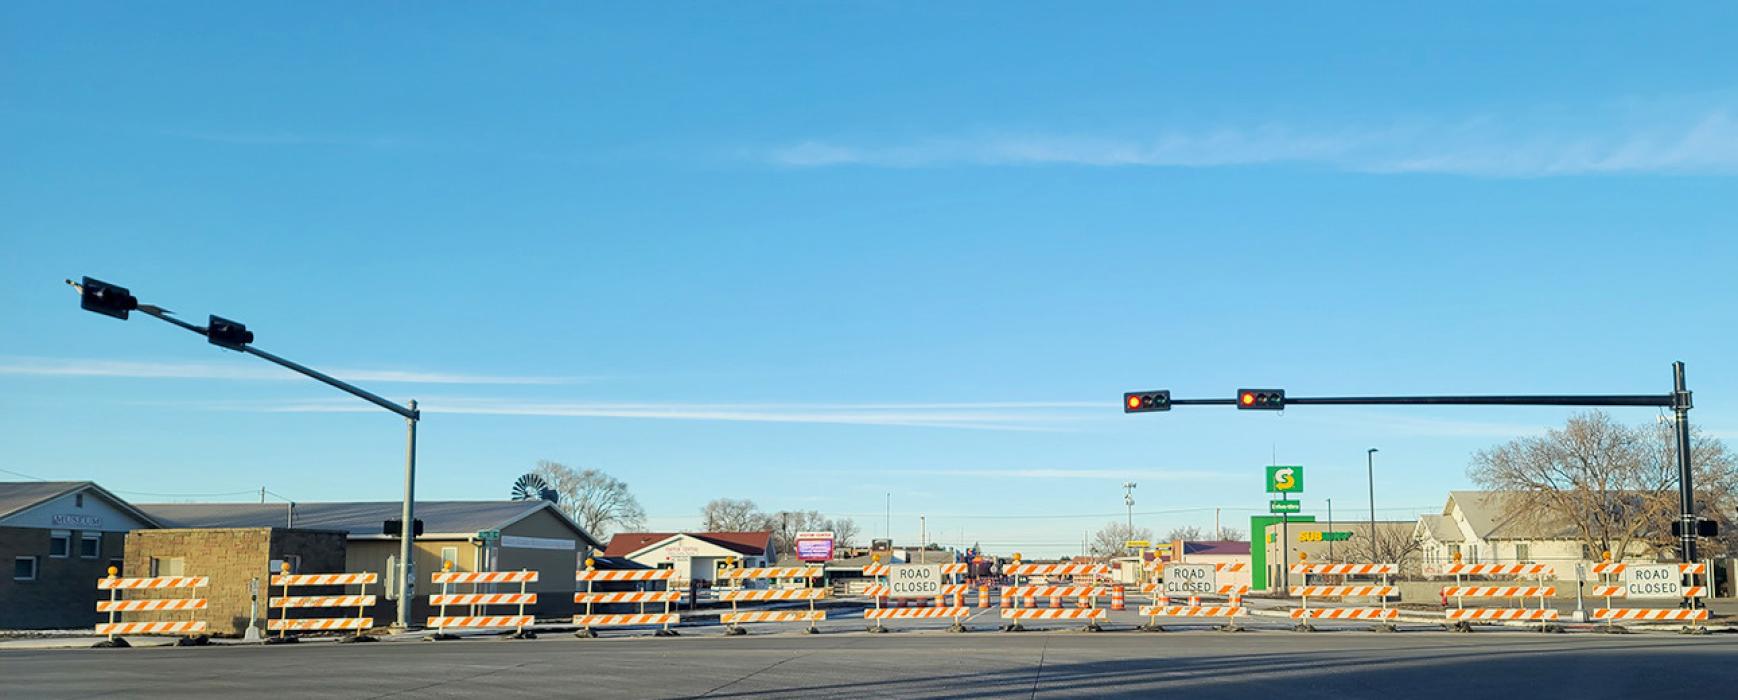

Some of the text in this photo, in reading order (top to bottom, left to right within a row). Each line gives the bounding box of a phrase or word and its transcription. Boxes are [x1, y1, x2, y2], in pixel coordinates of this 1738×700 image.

[900, 569, 930, 578] ROAD
[1174, 568, 1205, 578] ROAD
[1635, 569, 1669, 580] ROAD
[894, 582, 937, 592] CLOSED
[1168, 582, 1211, 591] CLOSED
[1630, 583, 1677, 593] CLOSED
